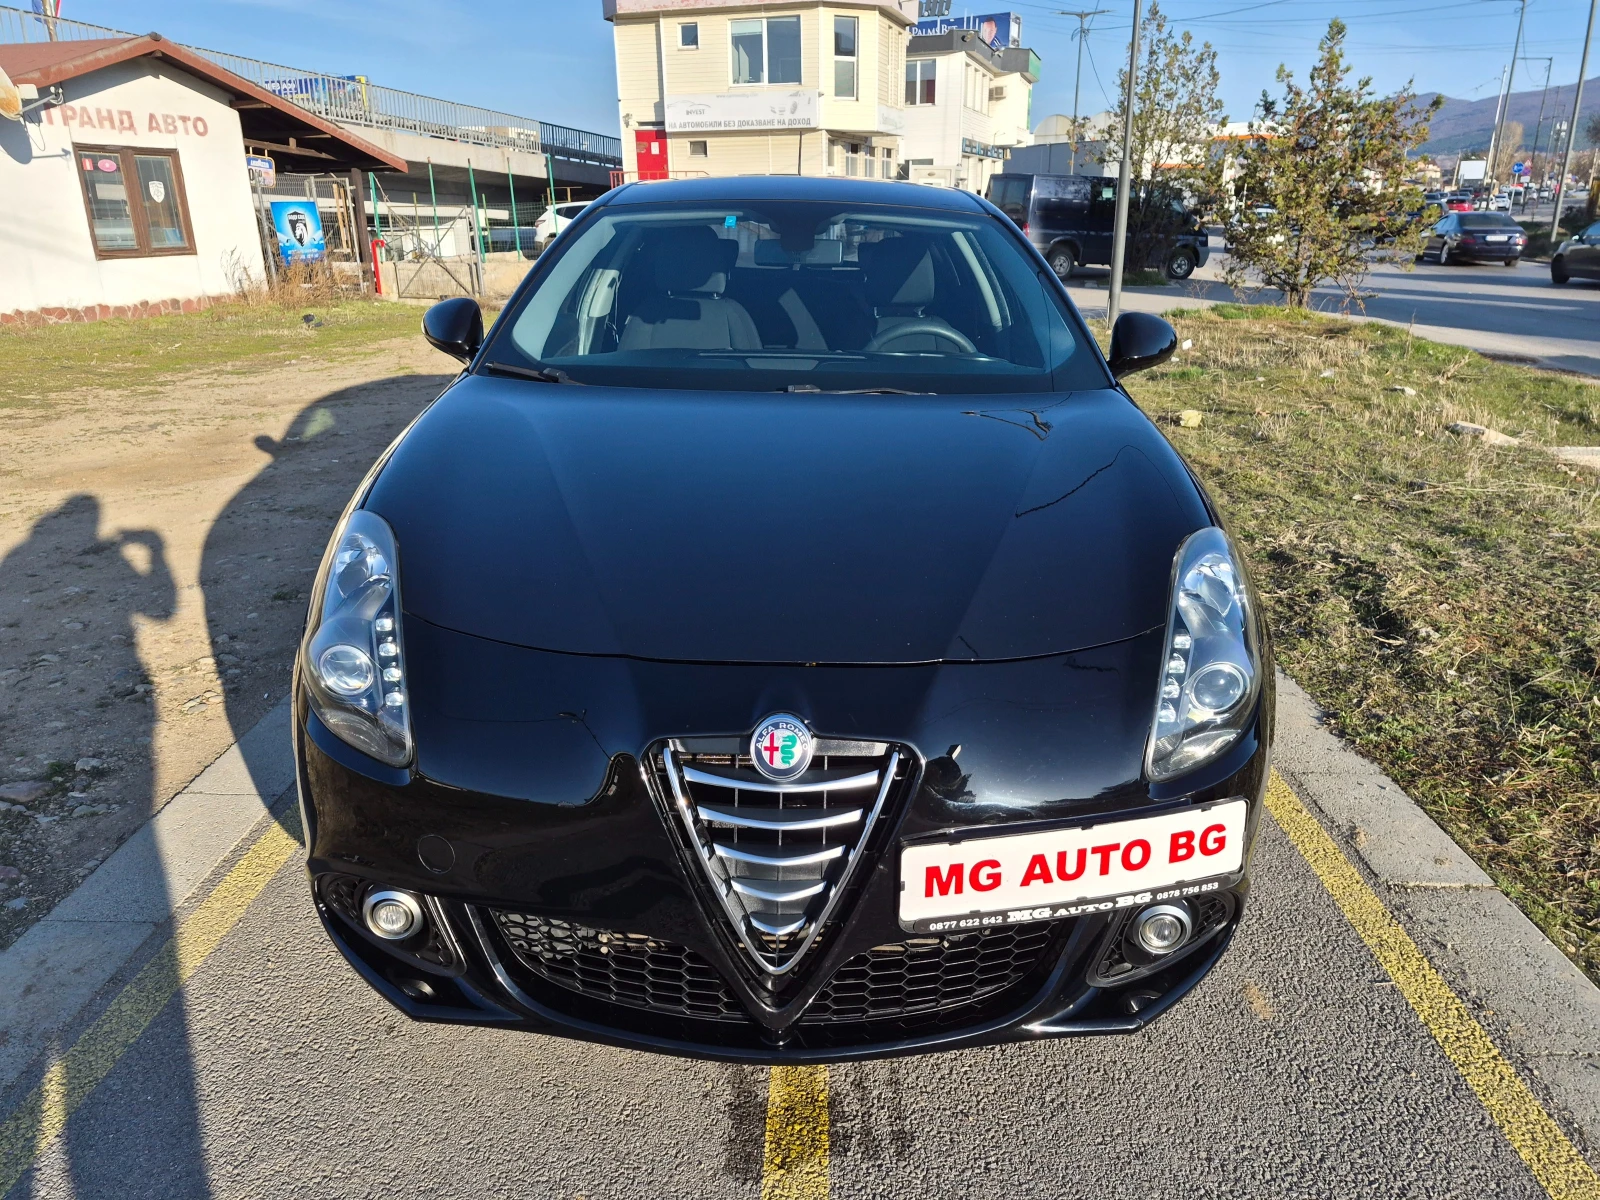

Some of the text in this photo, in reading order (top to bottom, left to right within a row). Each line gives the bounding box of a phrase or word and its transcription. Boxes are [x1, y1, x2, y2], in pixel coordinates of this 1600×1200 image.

[911, 27, 939, 36] PALMS
[43, 103, 209, 137] ГРАНД АВТО
[679, 121, 723, 129] АВТОМОБИЛИ
[724, 120, 736, 128] БЕЗ
[737, 118, 776, 128] ДОКАЗВАНЕ
[777, 118, 786, 126] НА
[787, 117, 811, 127] ДОХОД
[755, 722, 808, 751] ALFA ROMEO
[924, 823, 1227, 898] MG AUTO BG
[929, 881, 1219, 931] 0877 622 642 MG AUTO BG 0878 756 853
